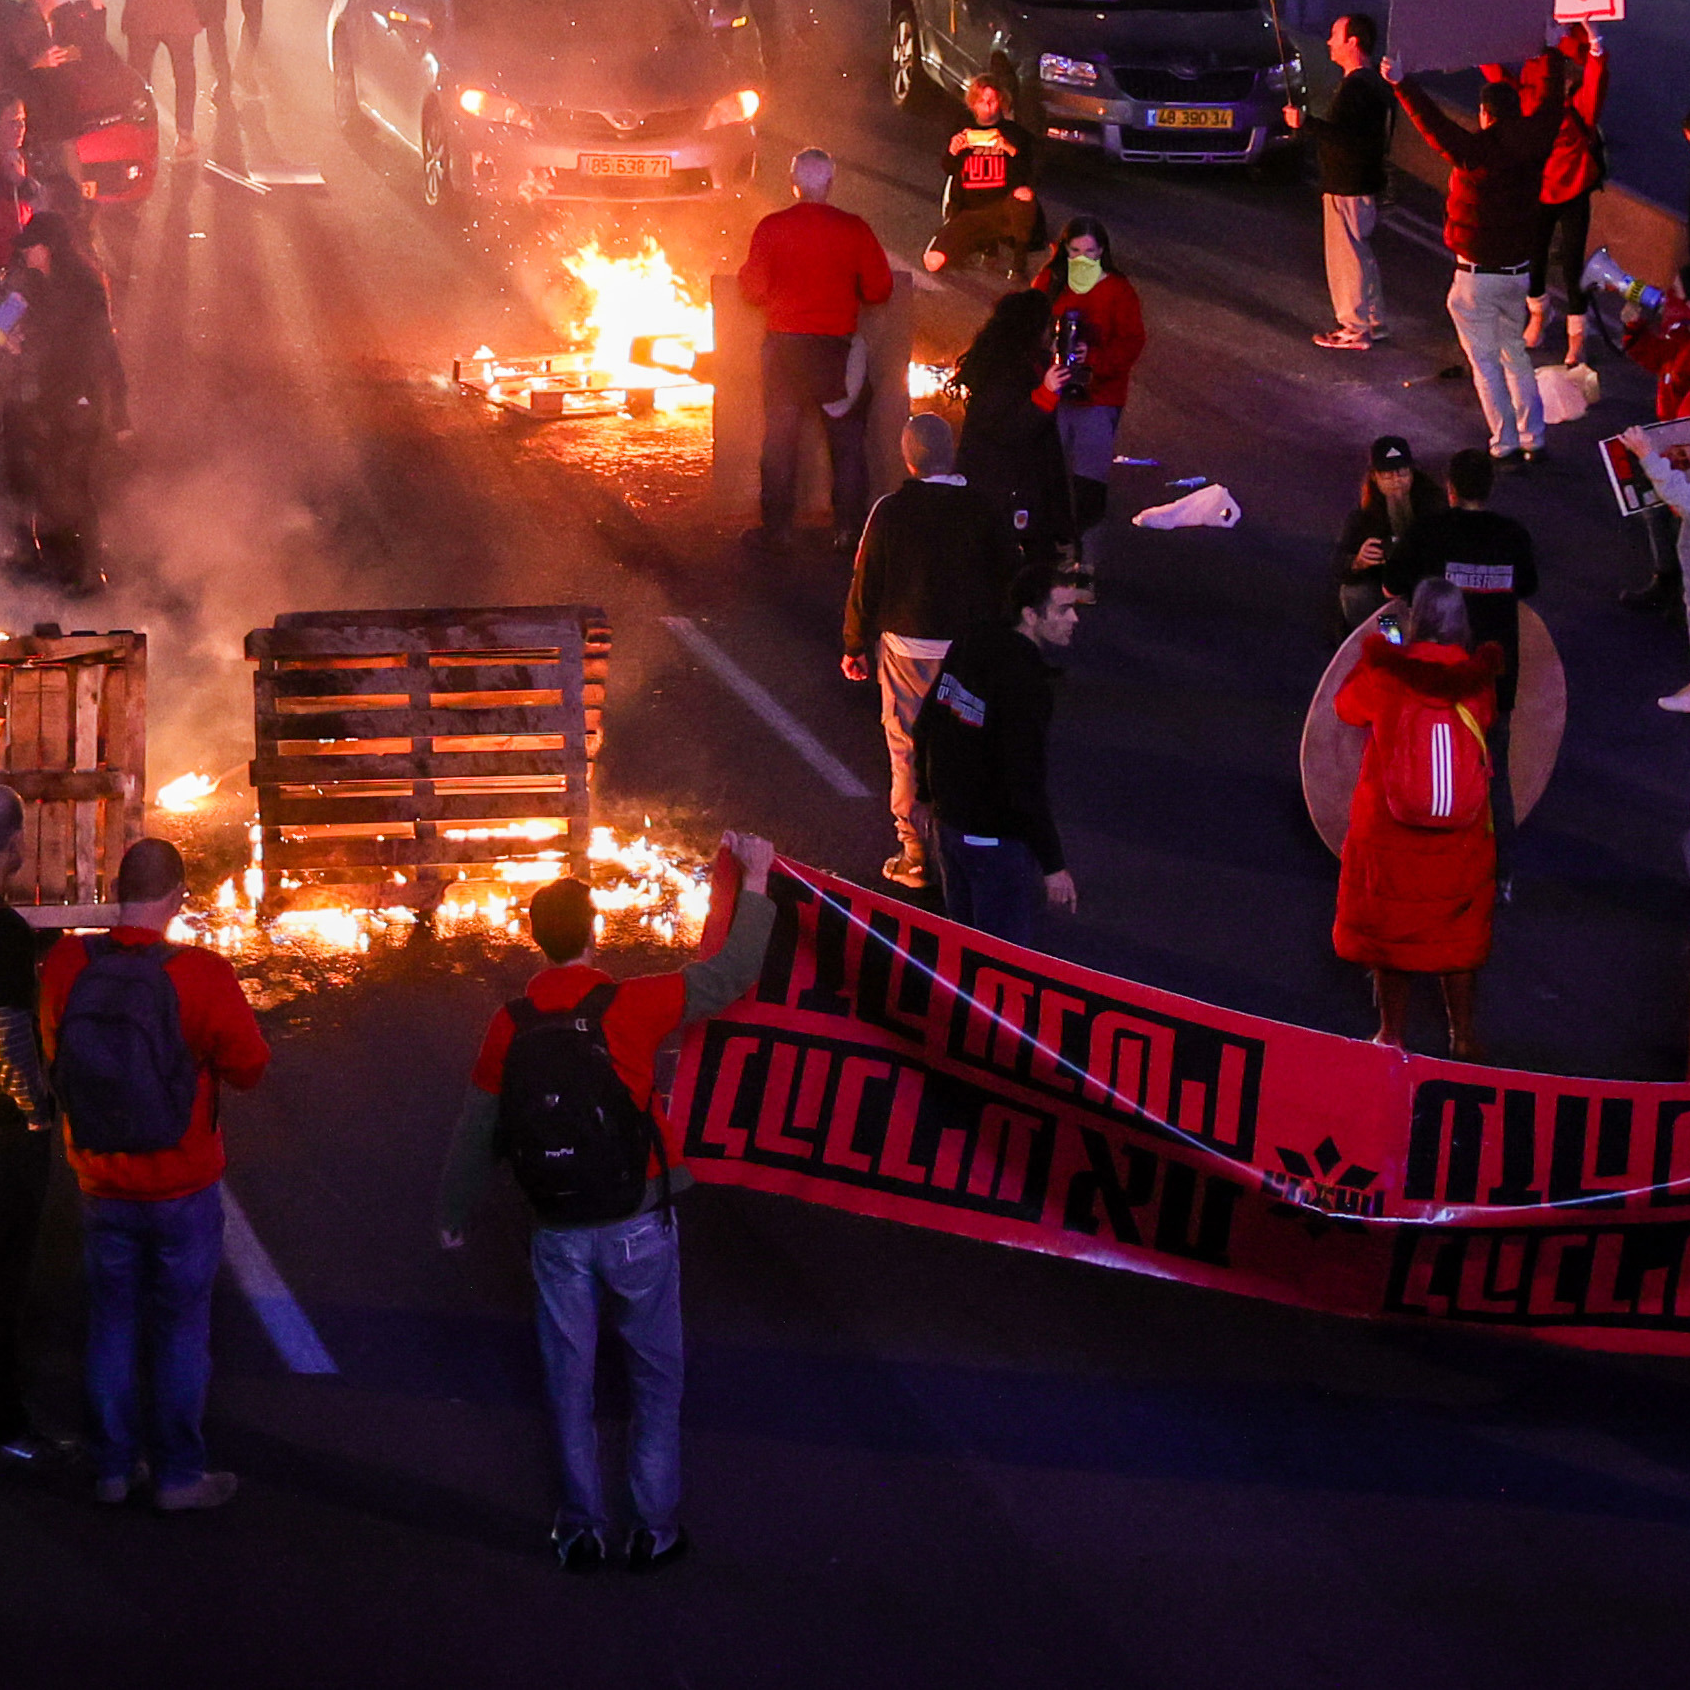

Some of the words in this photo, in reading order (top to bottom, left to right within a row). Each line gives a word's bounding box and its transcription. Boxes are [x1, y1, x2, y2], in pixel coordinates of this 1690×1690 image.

[963, 966, 1247, 1147] עכשיו
[1404, 1078, 1634, 1210] עזה
[701, 1035, 1043, 1204] להכריע
[1062, 1124, 1245, 1267] את
